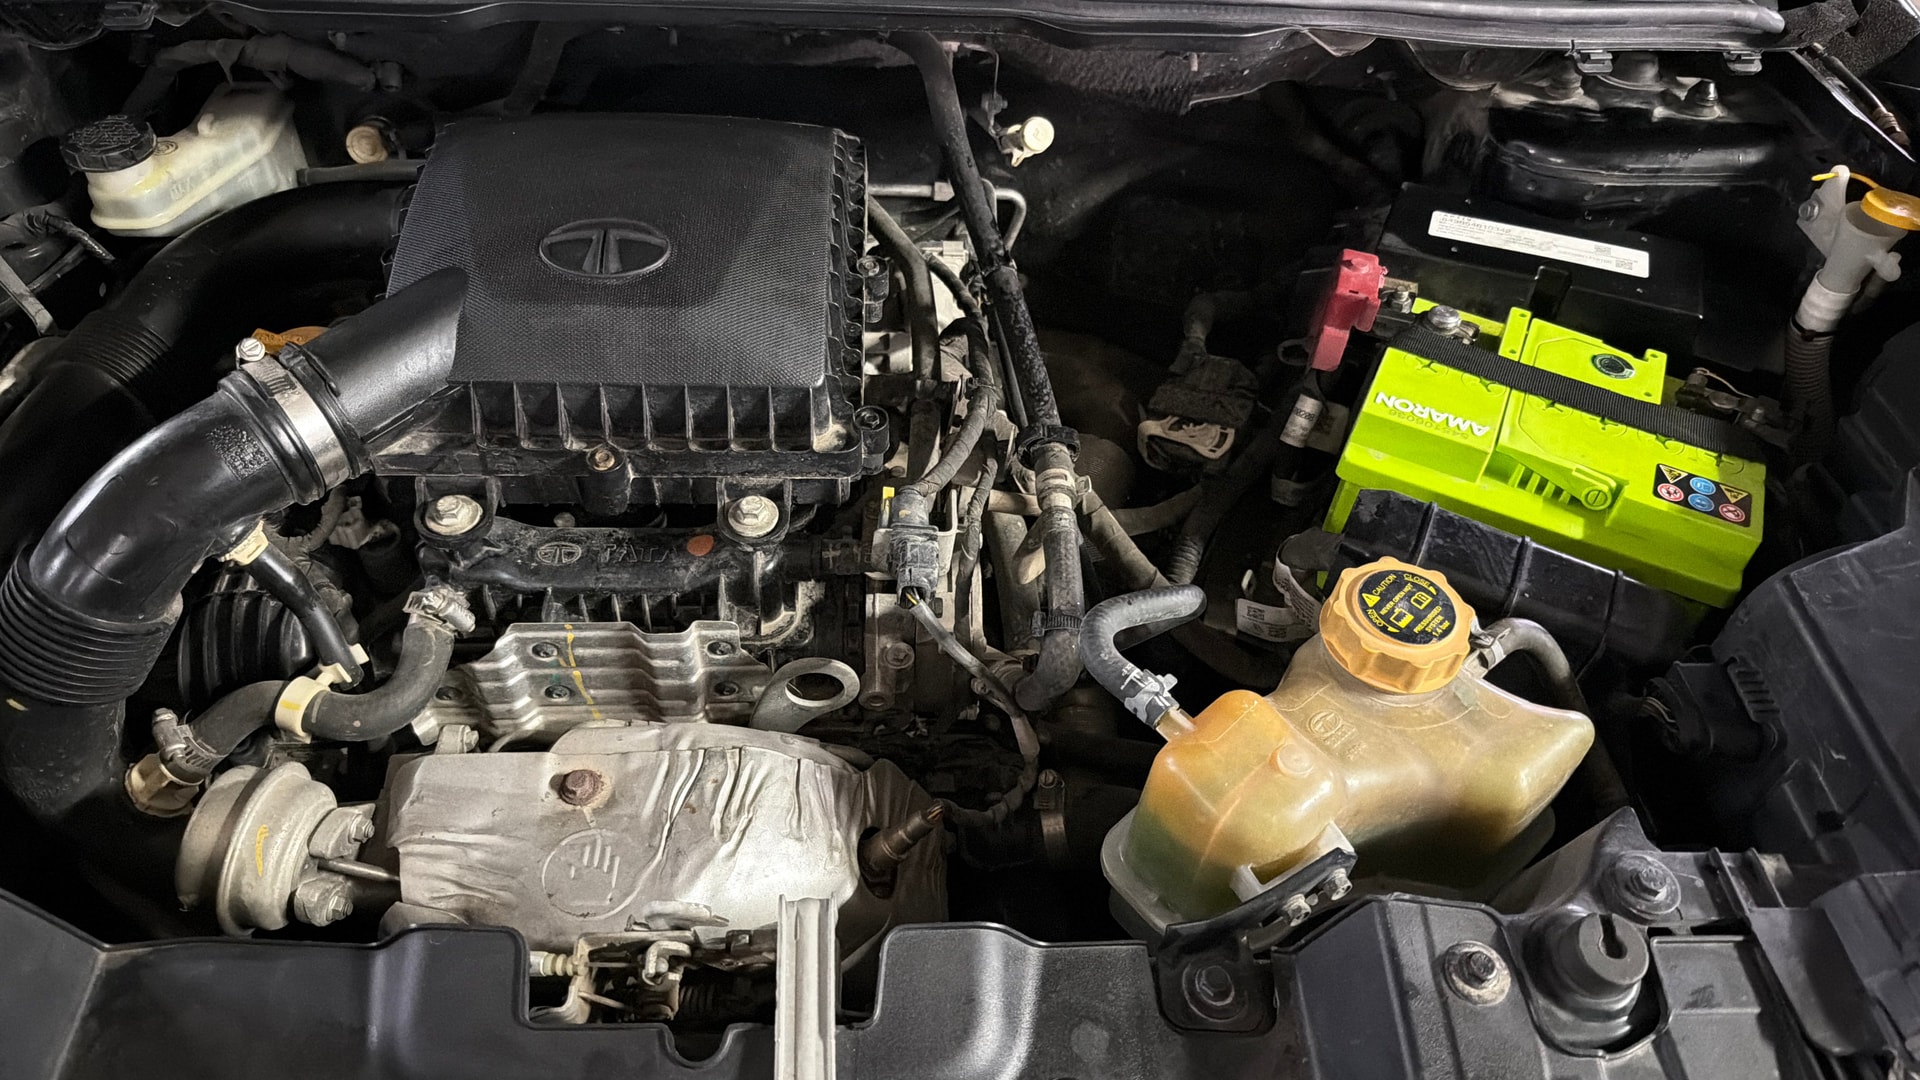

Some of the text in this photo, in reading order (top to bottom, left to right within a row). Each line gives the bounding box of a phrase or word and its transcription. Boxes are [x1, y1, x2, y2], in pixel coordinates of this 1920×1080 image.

[1374, 391, 1491, 437] AMARON
[1372, 573, 1397, 596] CAUTION
[1403, 573, 1431, 588] CLOSE
[1380, 583, 1414, 615] NEVER OPEN HOT
[1366, 609, 1384, 627] OPEN
[1425, 615, 1445, 633] SYSTEM
